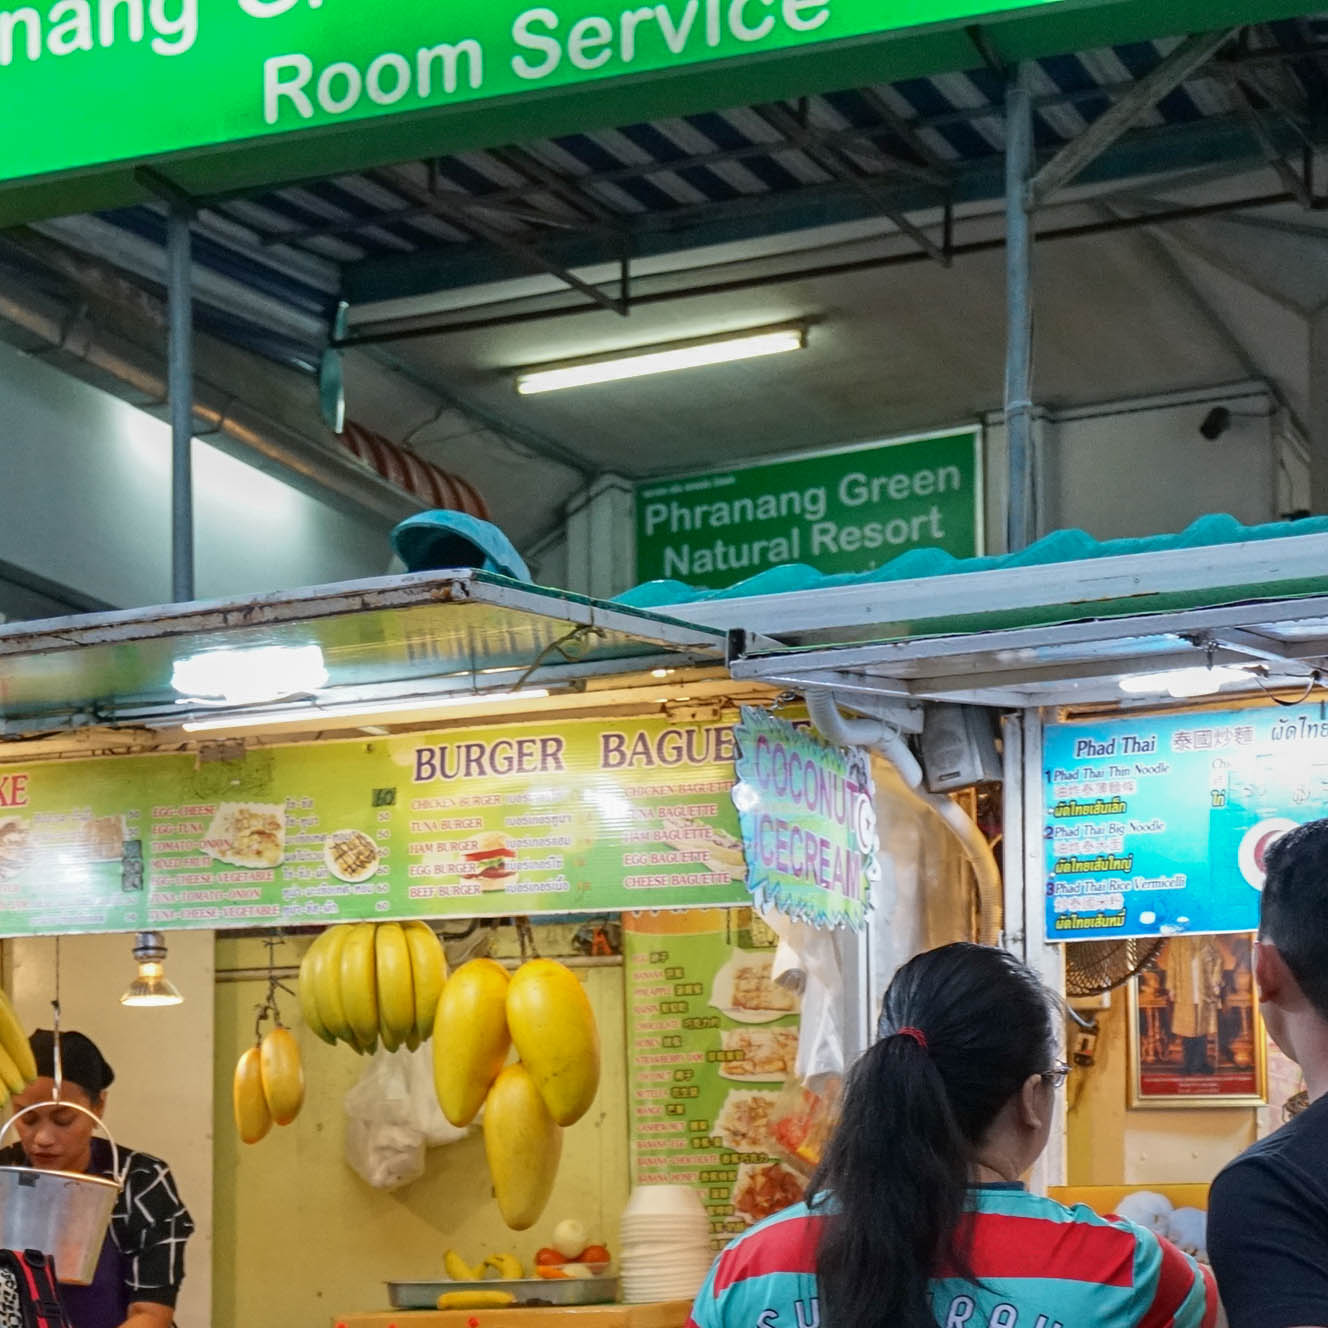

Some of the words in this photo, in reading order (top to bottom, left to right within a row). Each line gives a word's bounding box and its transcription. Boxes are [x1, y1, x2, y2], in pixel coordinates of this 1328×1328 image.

[263, 39, 483, 125] Room
[511, 0, 830, 80] Service
[645, 486, 826, 537] Phranang
[839, 465, 961, 506] Green
[663, 527, 800, 578] Natural
[811, 506, 945, 556] Resort
[601, 726, 736, 769] BAGUE
[1076, 738, 1116, 758] Phad
[1121, 735, 1157, 755] Thai
[413, 737, 565, 782] BURGER
[1053, 767, 1080, 782] Phad
[1134, 761, 1170, 775] Noodle
[754, 734, 871, 832] COCONUT
[658, 804, 717, 818] BAGUETTE
[440, 817, 482, 831] BURGER
[653, 827, 713, 841] BAGUETTE
[436, 840, 479, 853] BURGER
[623, 853, 649, 866] EGG
[650, 850, 711, 865] BAGUETTE
[753, 813, 862, 900] ICECREAM
[409, 865, 432, 877] EGG
[434, 862, 477, 876] BURGER
[624, 875, 669, 889] CHEESE
[671, 872, 732, 886] BAGUETTE
[1054, 881, 1080, 896] Phad
[409, 886, 436, 899] BEEF
[438, 884, 482, 898] BURGER
